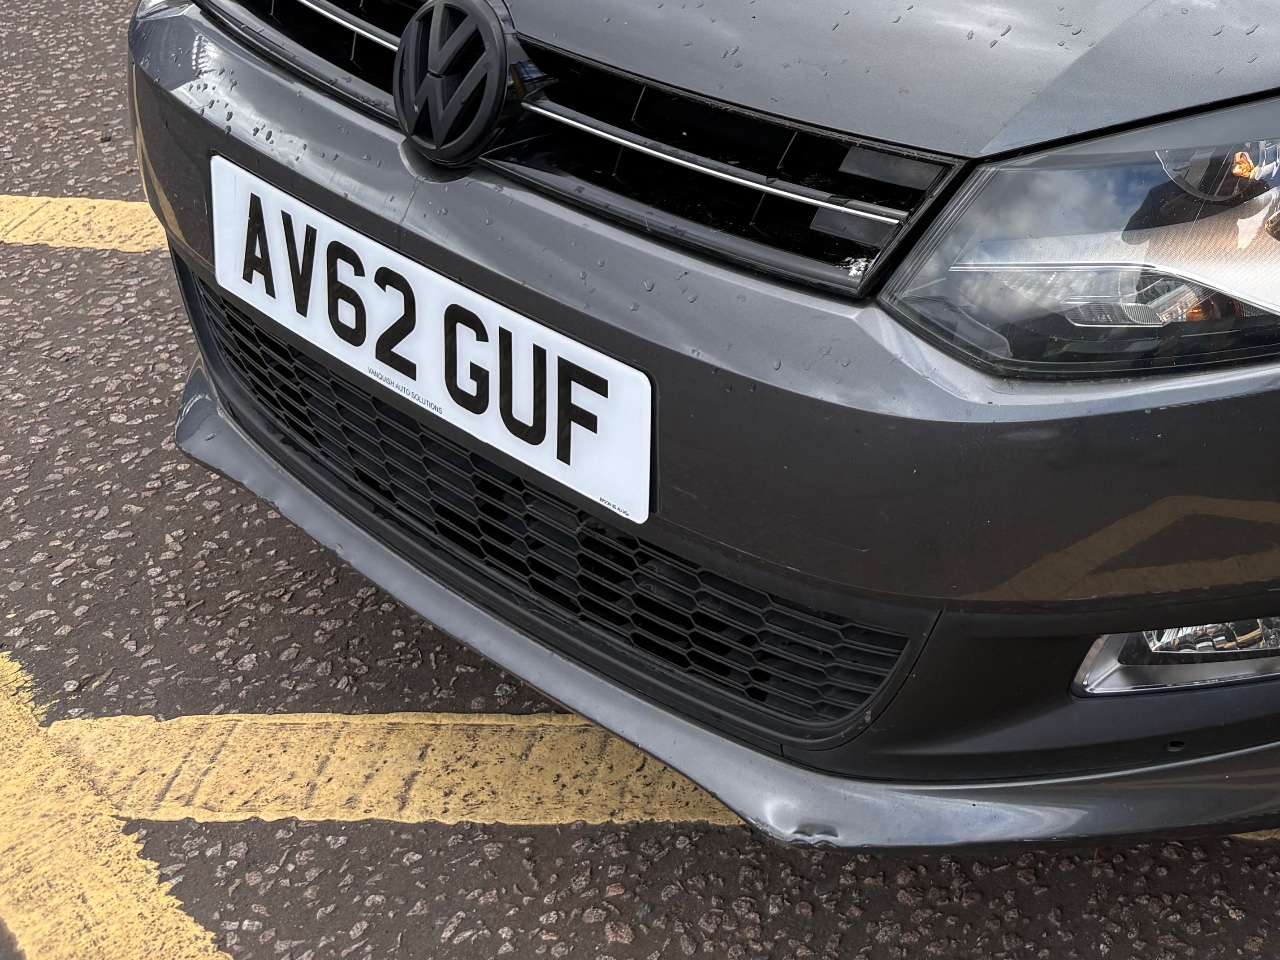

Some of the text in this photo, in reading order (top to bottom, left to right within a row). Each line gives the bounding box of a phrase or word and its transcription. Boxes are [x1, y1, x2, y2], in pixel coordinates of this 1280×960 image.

[242, 192, 609, 466] AV62 GUF
[367, 366, 443, 415] VANQUISH AUTO SOLUTIONS
